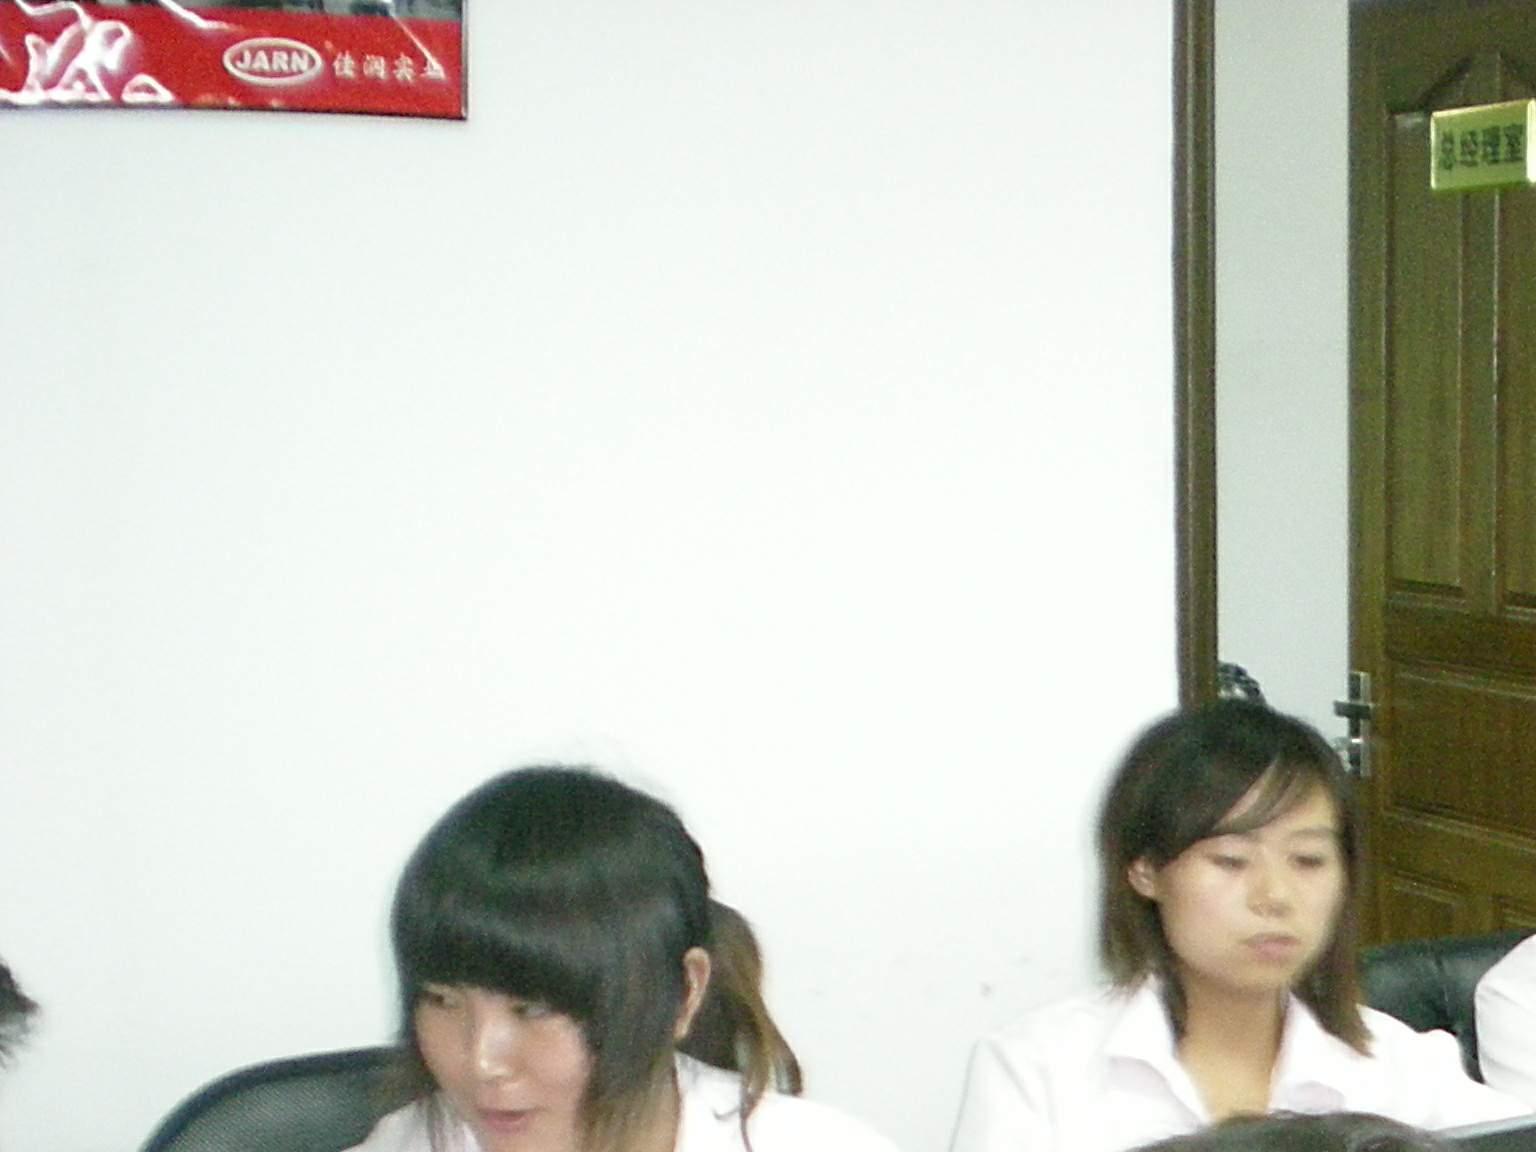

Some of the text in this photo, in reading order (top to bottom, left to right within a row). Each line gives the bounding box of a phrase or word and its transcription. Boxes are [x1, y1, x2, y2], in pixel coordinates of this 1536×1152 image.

[235, 49, 309, 71] JARN
[1438, 123, 1524, 171] 总经理室
